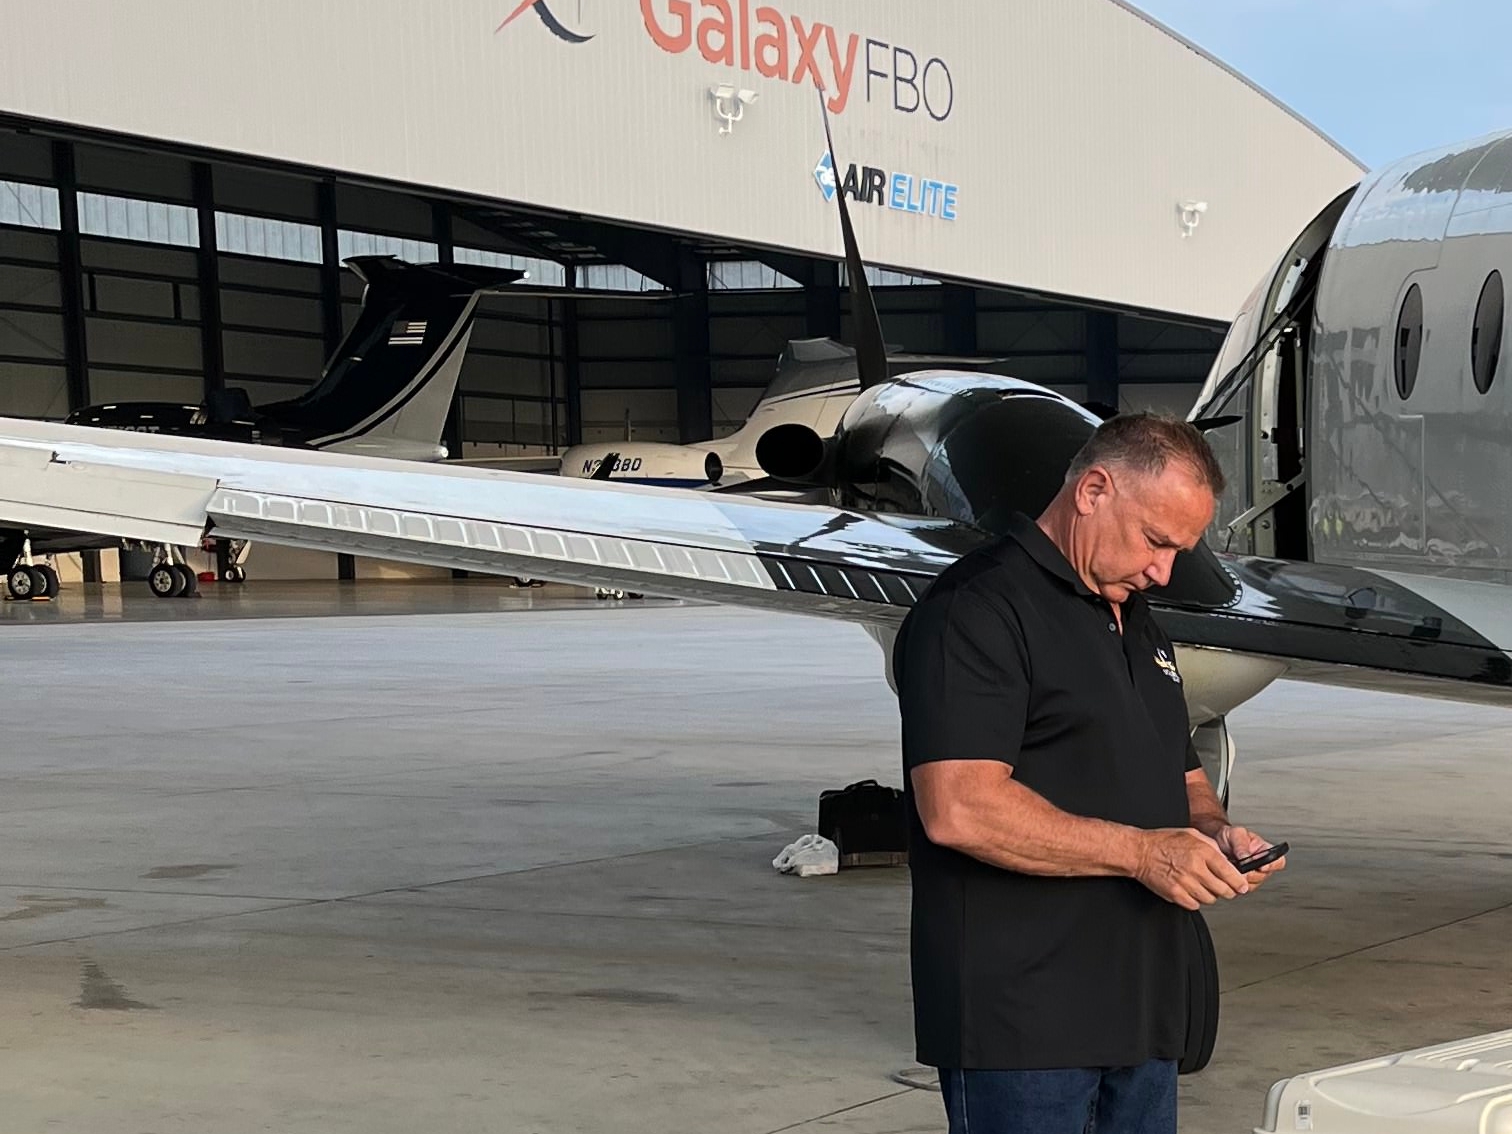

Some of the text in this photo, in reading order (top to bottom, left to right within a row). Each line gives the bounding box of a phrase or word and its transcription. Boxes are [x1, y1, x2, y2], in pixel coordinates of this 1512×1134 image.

[639, 0, 953, 121] Galaxy FBO
[842, 163, 959, 220] AIR ELITE
